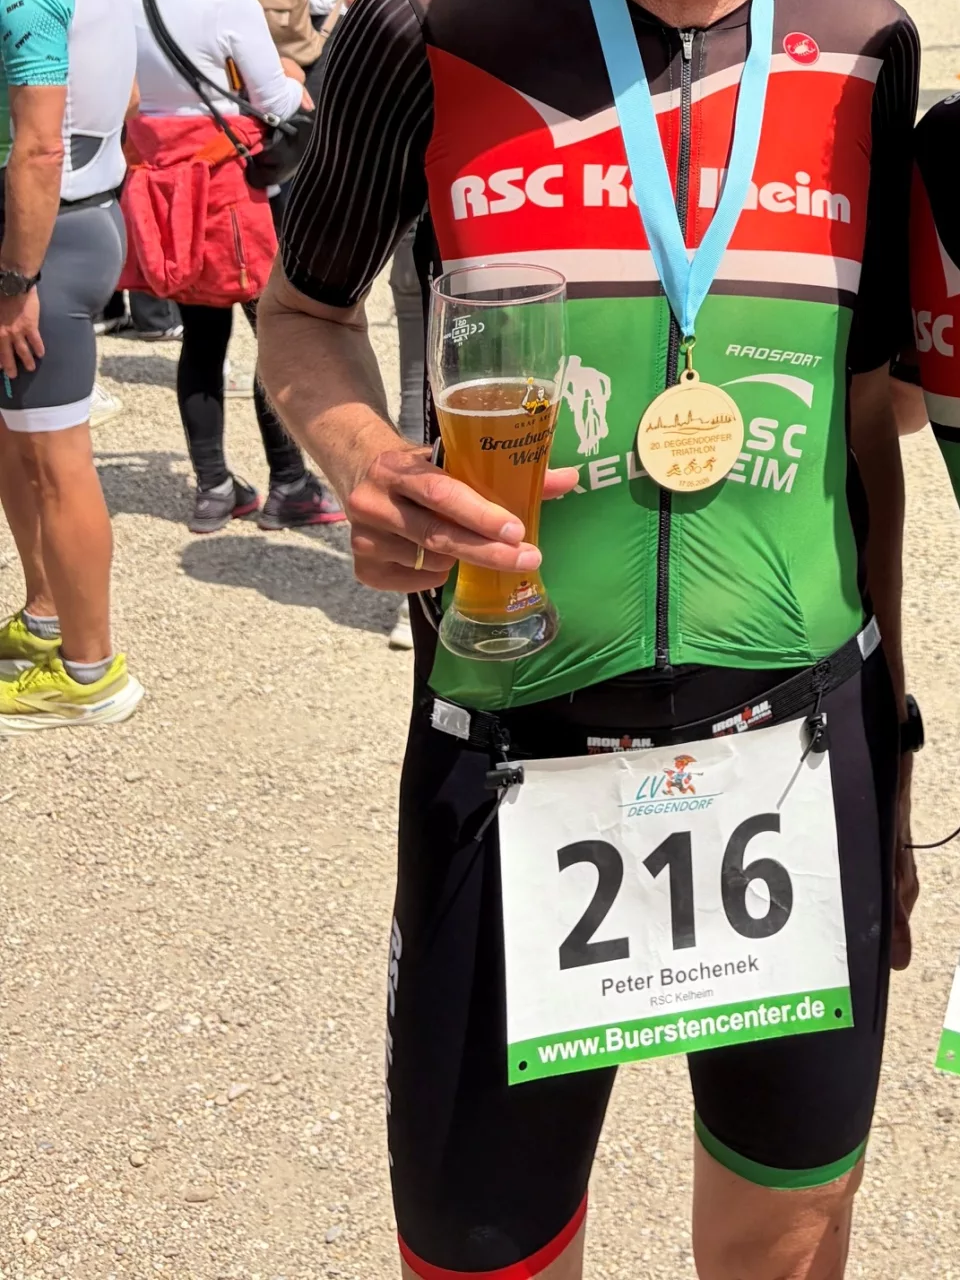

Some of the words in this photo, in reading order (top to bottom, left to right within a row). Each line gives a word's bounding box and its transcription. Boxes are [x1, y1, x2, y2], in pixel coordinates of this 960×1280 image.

[450, 163, 564, 220] RSC
[725, 343, 823, 368] RADSPORT
[664, 433, 732, 448] DEGGENDORFER
[746, 417, 807, 458] SC
[671, 445, 716, 457] TRIATHLON
[635, 775, 666, 801] LV
[627, 798, 714, 818] DEGGENDORF
[556, 813, 794, 971] 216
[601, 973, 653, 997] Peter
[660, 954, 760, 987] Bochenek
[650, 994, 673, 1007] RSC
[675, 987, 714, 1003] Kelheim
[536, 996, 825, 1065] www.Buerstencenter.de
